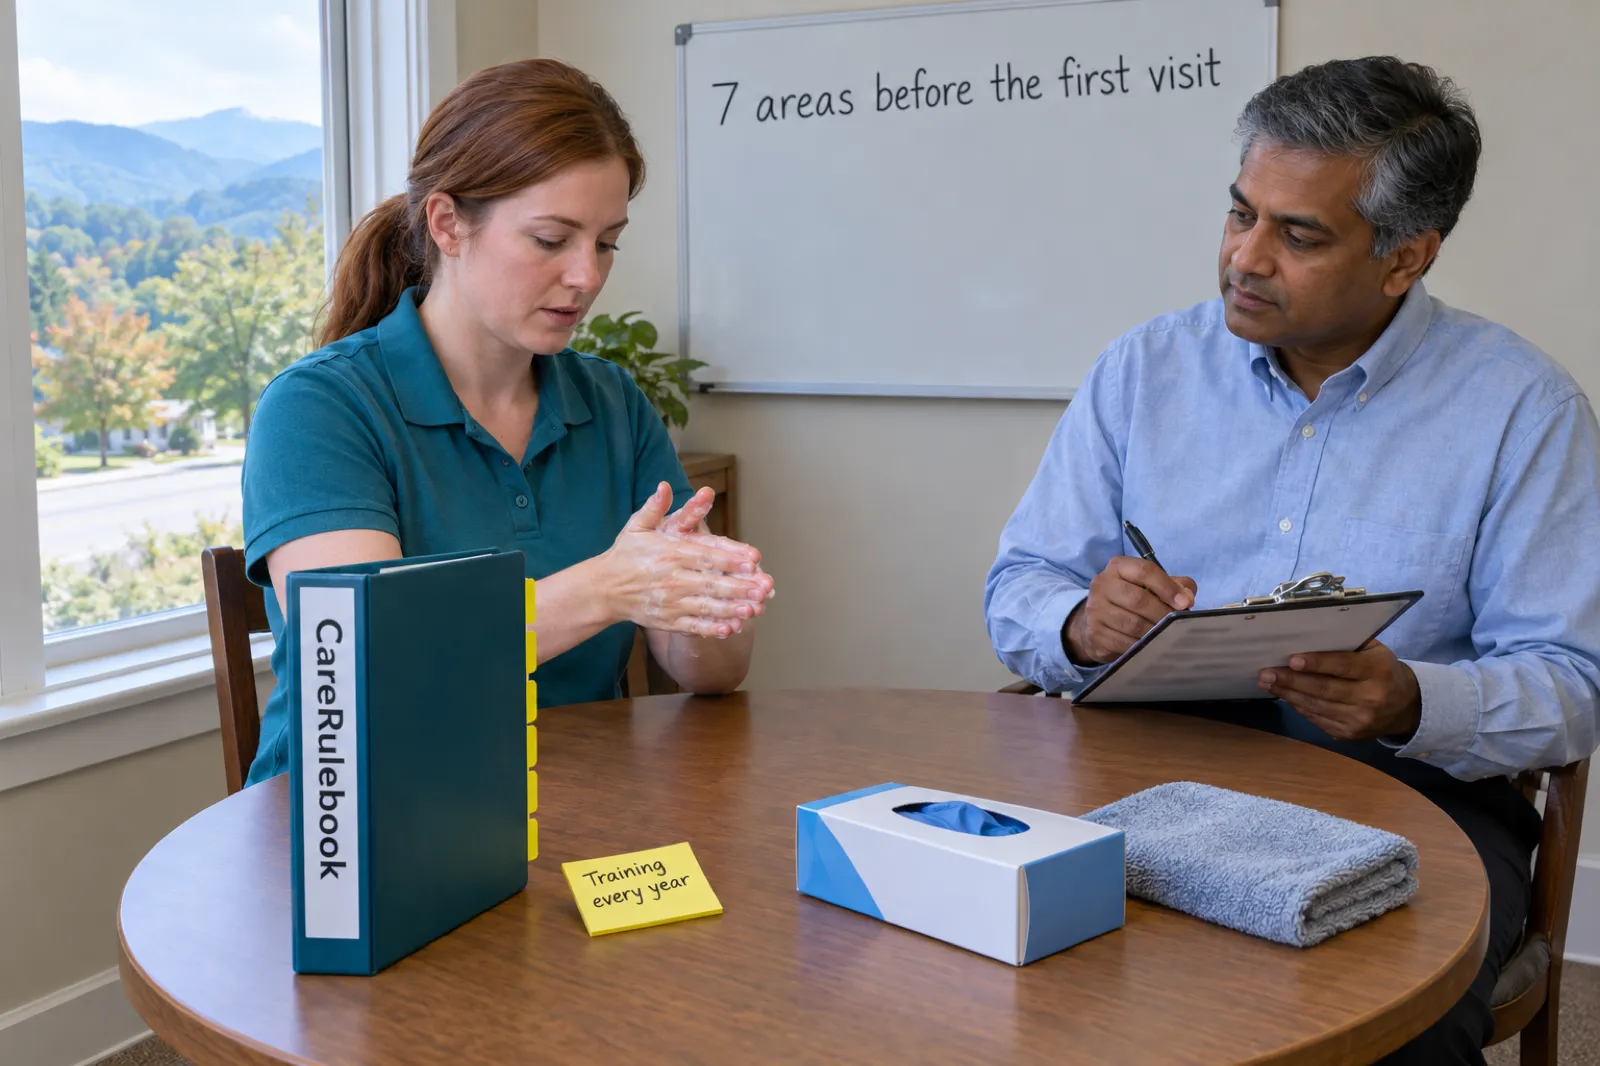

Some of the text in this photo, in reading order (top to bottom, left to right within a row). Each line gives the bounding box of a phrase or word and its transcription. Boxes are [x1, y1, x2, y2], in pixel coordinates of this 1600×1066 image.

[712, 48, 1220, 125] 7 areas before the first visit
[316, 619, 346, 879] CareRulebook
[583, 861, 666, 886] Training
[594, 876, 689, 907] every year
